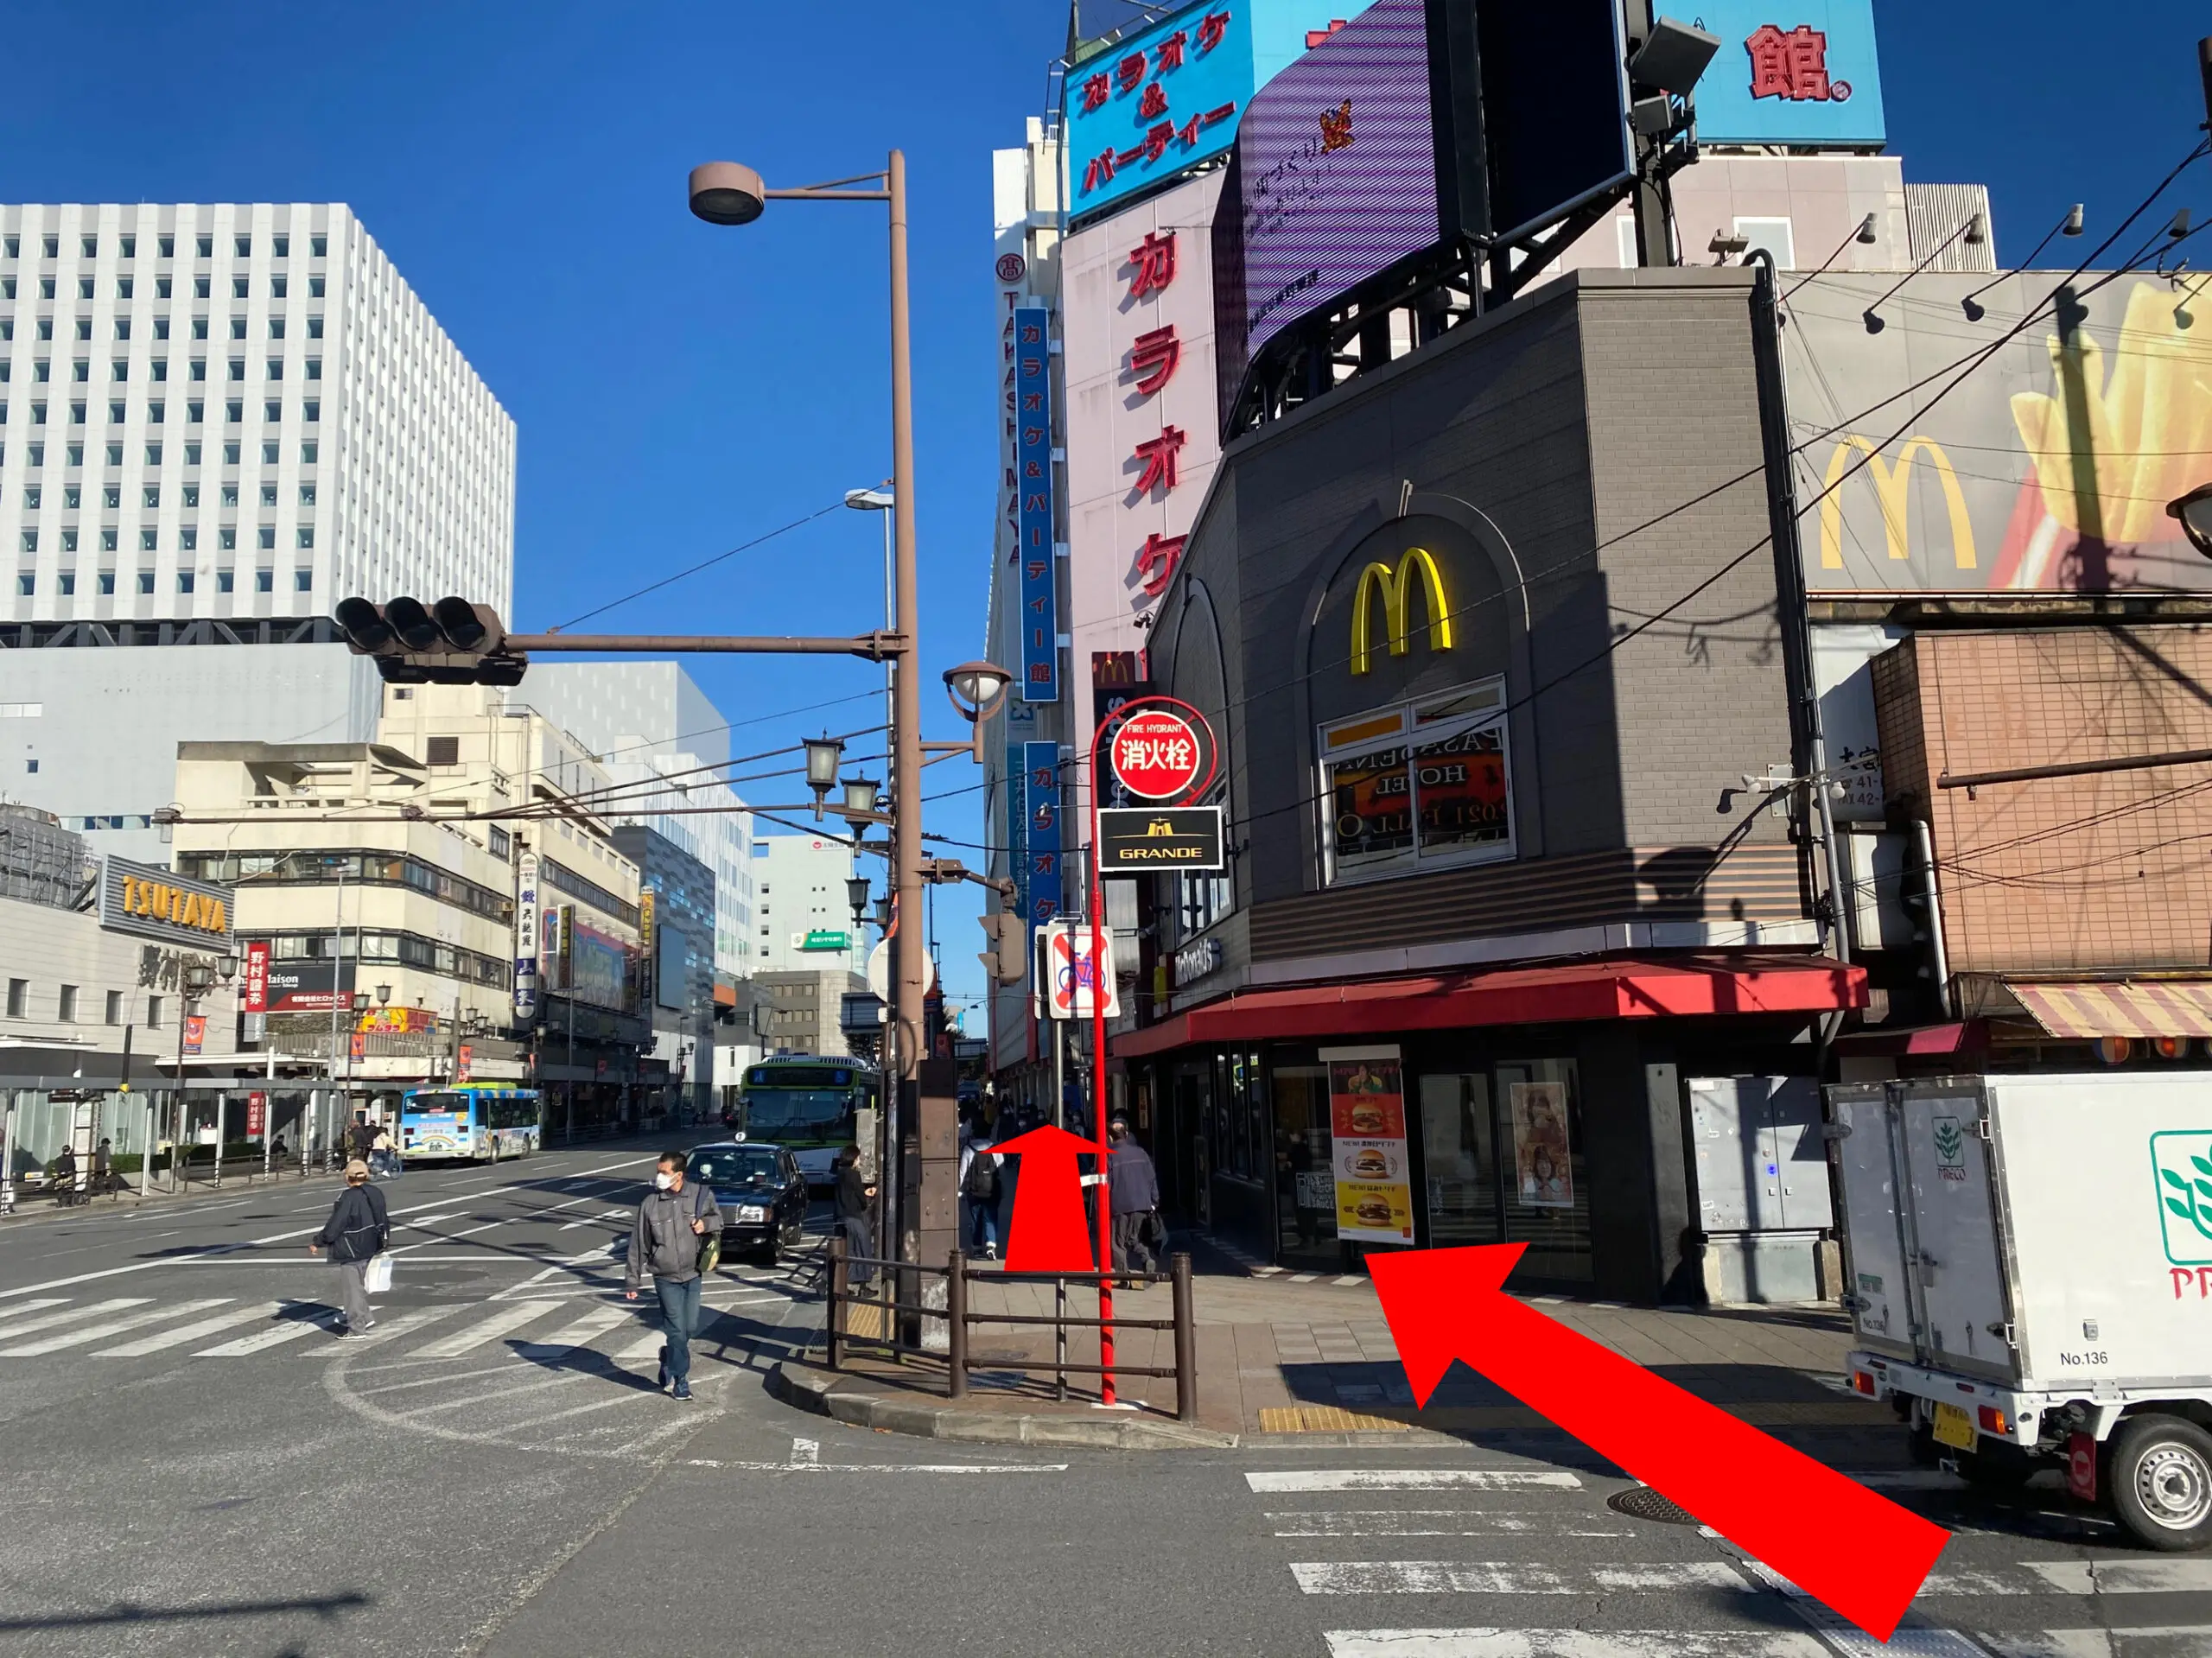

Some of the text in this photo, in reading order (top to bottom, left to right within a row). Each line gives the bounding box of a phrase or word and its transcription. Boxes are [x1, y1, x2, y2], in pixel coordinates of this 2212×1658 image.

[1083, 10, 1231, 111] カラオケ
[1744, 25, 1830, 101] 館
[1141, 82, 1168, 118] &
[1084, 100, 1236, 191] パーティー
[1128, 231, 1189, 597] カラオケ
[1121, 738, 1192, 771] 消火栓
[1127, 724, 1182, 734] FIRE HYDRANT
[1033, 767, 1056, 919] カラオケ
[1119, 848, 1203, 860] GRANDE
[123, 875, 226, 933] TSUTAYA
[2060, 1351, 2108, 1365] No.136
